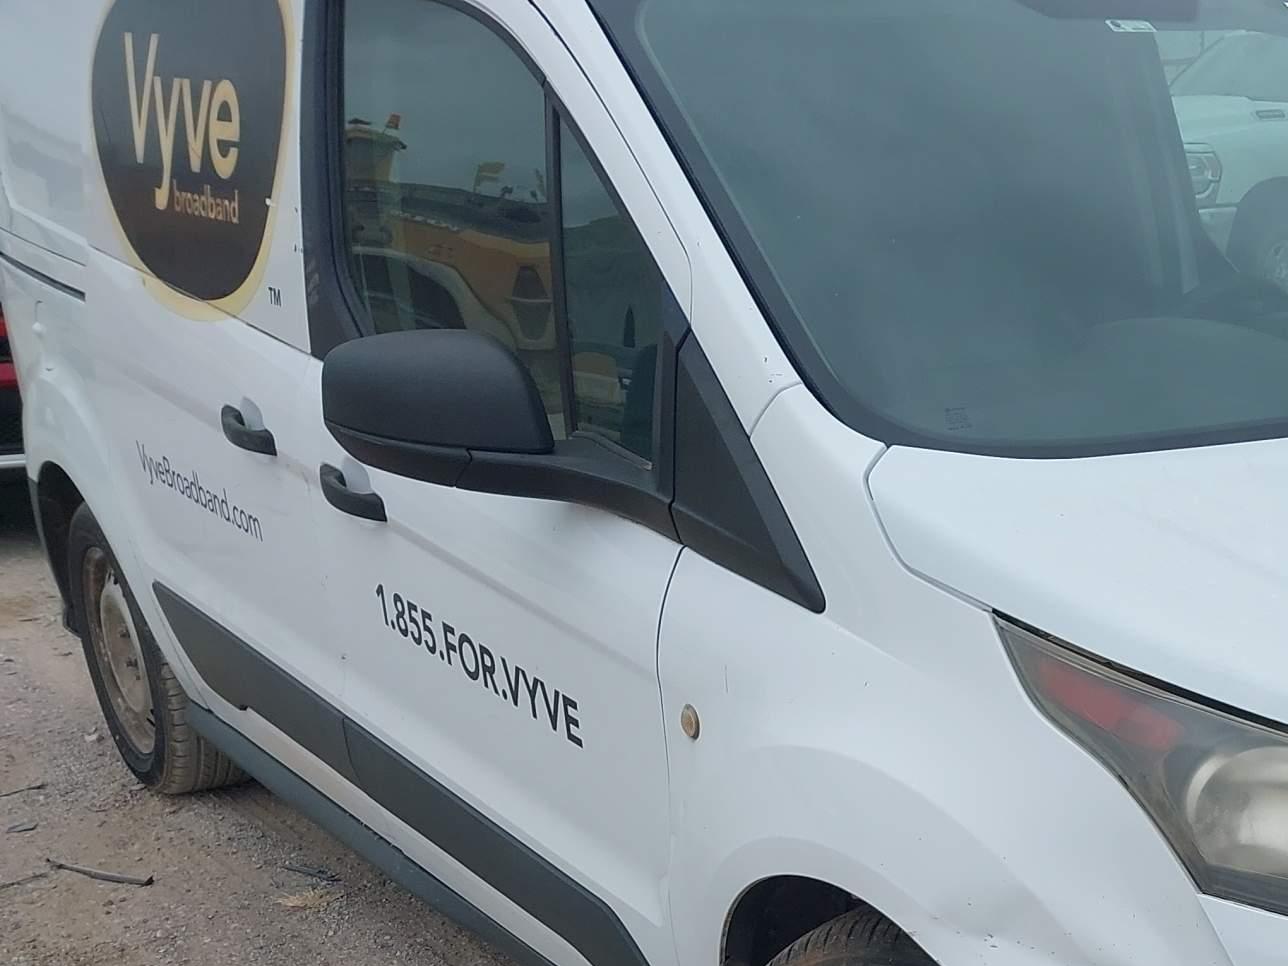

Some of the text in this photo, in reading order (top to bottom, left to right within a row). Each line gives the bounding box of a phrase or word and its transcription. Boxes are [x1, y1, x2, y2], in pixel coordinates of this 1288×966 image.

[124, 32, 240, 210] Vyve
[173, 179, 239, 224] broadband
[268, 287, 282, 307] TM
[136, 440, 263, 542] VyveBroadband.com
[376, 584, 583, 748] 1.855.FOR.VYVE
